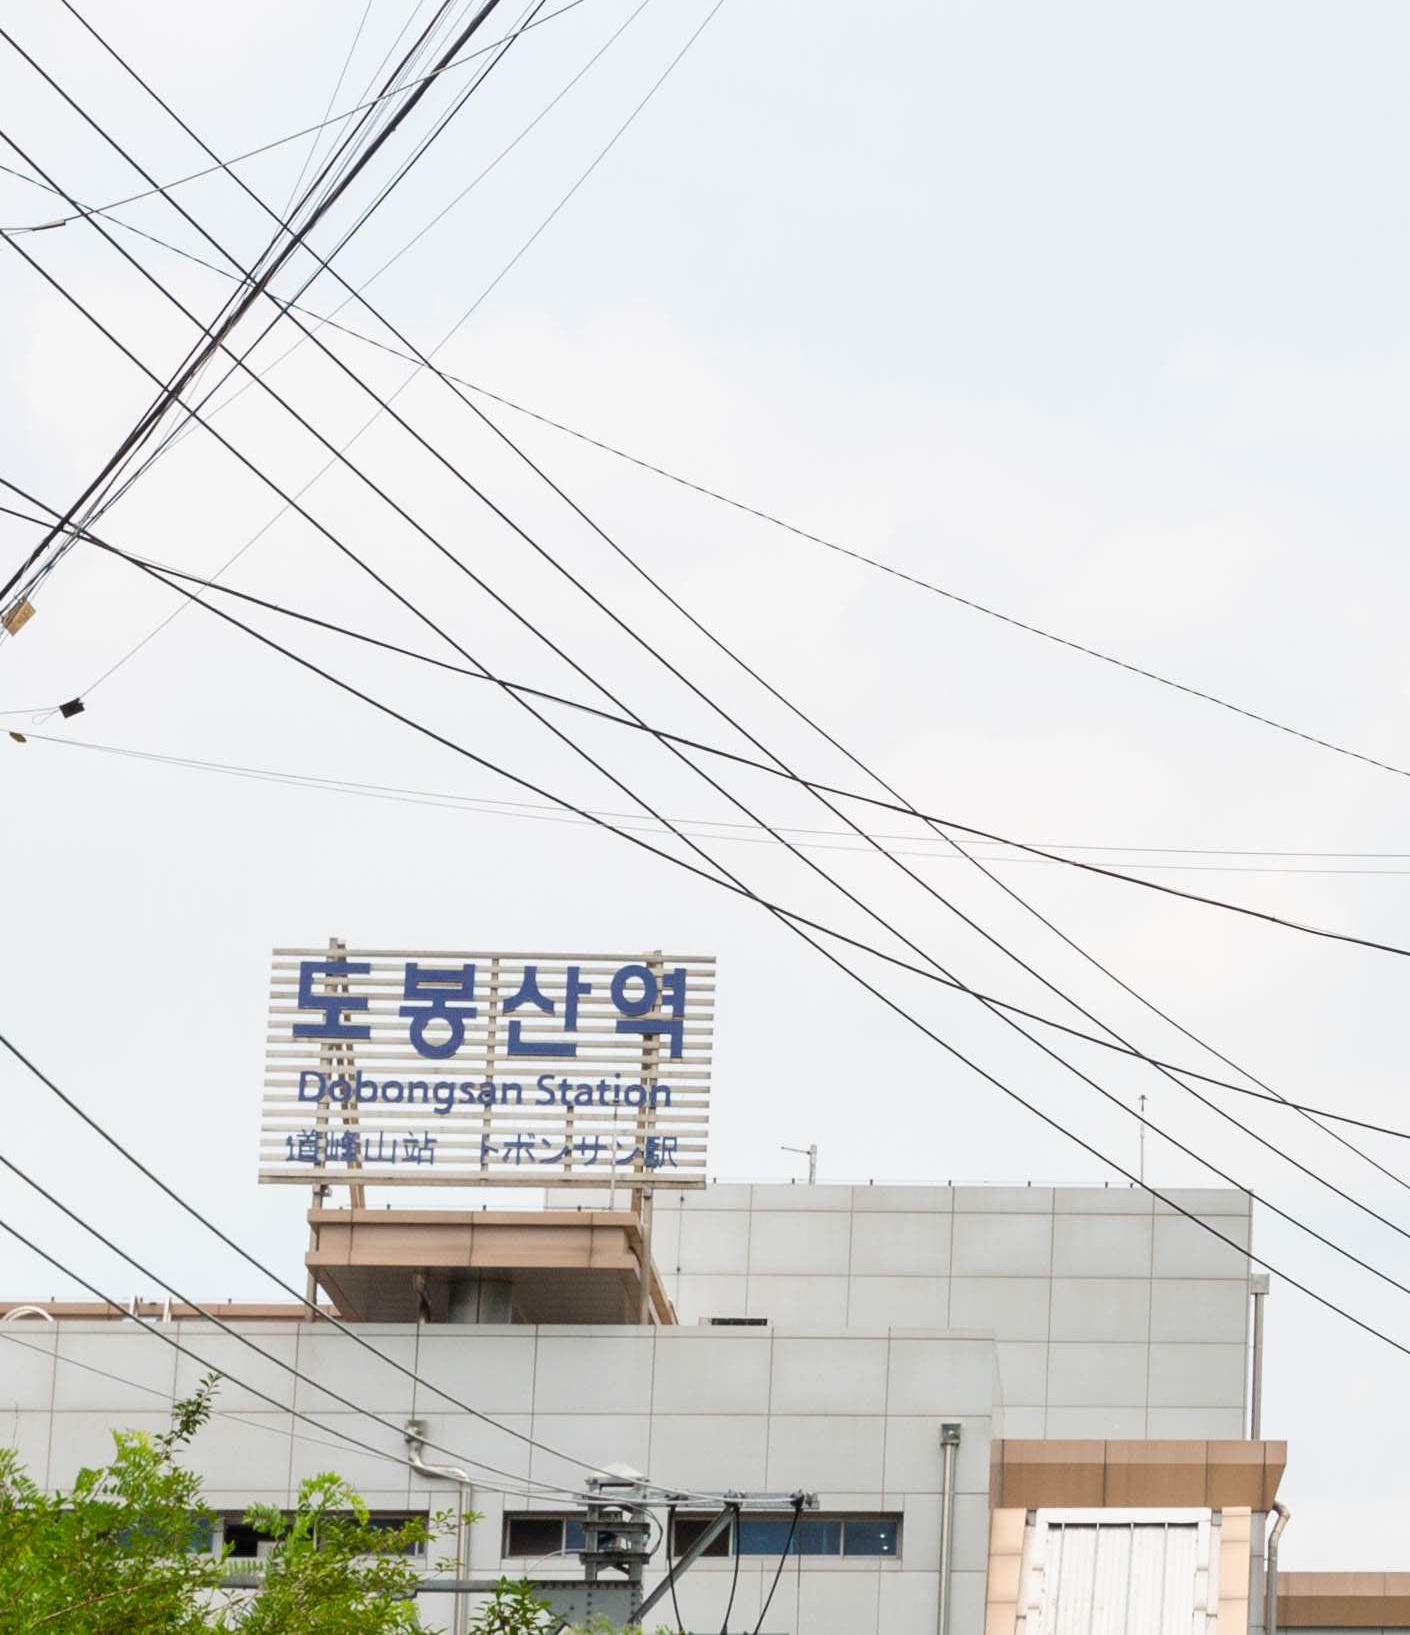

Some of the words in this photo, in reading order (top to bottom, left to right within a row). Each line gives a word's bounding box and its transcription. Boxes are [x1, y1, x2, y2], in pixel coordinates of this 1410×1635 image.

[292, 961, 687, 1059] 도봉산역
[298, 1069, 523, 1115] Dobongsan
[535, 1072, 673, 1108] Station
